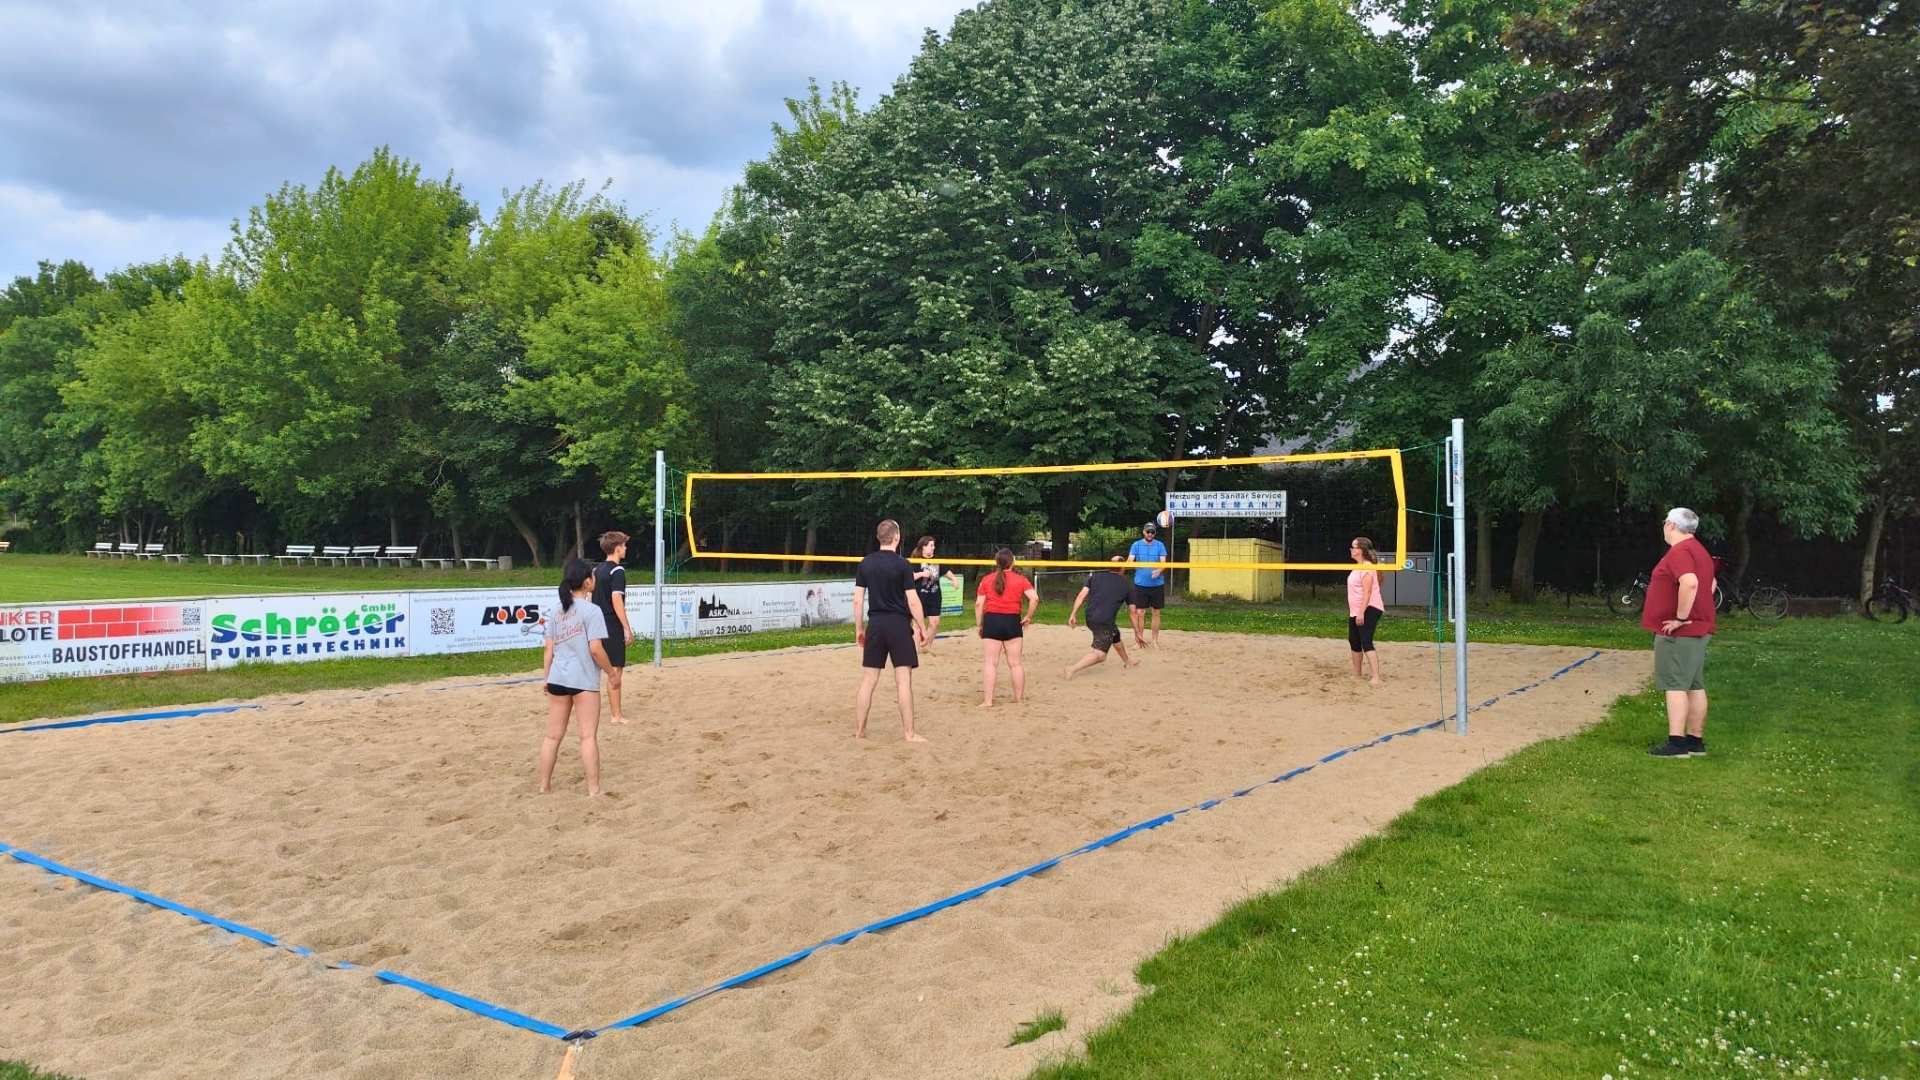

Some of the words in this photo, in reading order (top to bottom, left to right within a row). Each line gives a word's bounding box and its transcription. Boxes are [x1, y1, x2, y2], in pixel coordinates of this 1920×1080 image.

[1169, 492, 1200, 500] Heizung
[1251, 491, 1281, 499] Service
[361, 603, 396, 612] GmbH
[211, 607, 405, 643] Schröter
[716, 626, 726, 635] 25
[727, 625, 737, 634] 20
[52, 639, 206, 664] BAUSTOFFHANDEL
[211, 636, 406, 660] PUMPENTECHNIK
